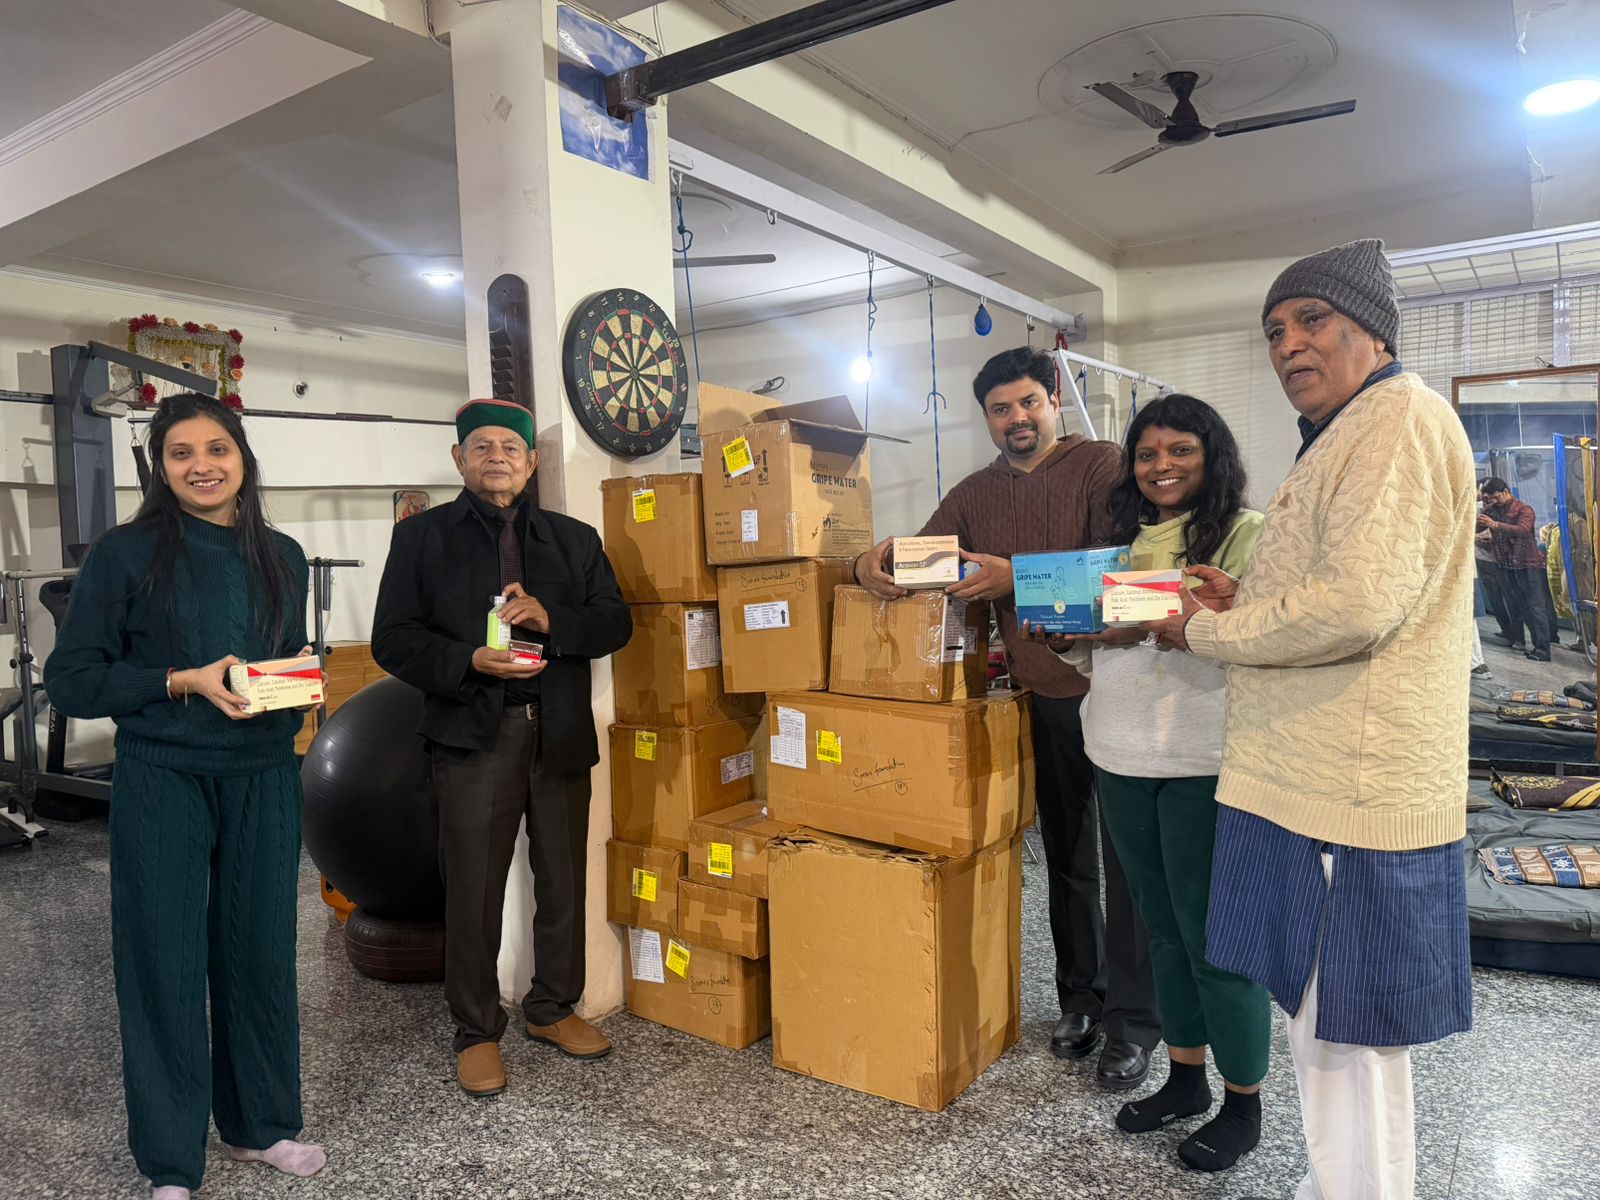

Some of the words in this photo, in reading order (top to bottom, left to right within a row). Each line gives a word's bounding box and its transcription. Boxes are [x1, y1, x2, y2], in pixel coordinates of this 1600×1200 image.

[601, 296, 609, 306] 11
[617, 292, 624, 302] 14
[649, 303, 656, 312] 12
[588, 310, 595, 318] 8
[579, 329, 587, 339] 16
[673, 337, 680, 348] 20
[577, 378, 586, 388] 19
[585, 402, 592, 410] 3
[597, 422, 605, 431] 17
[811, 473, 833, 485] GRIPE
[833, 476, 857, 488] WATER
